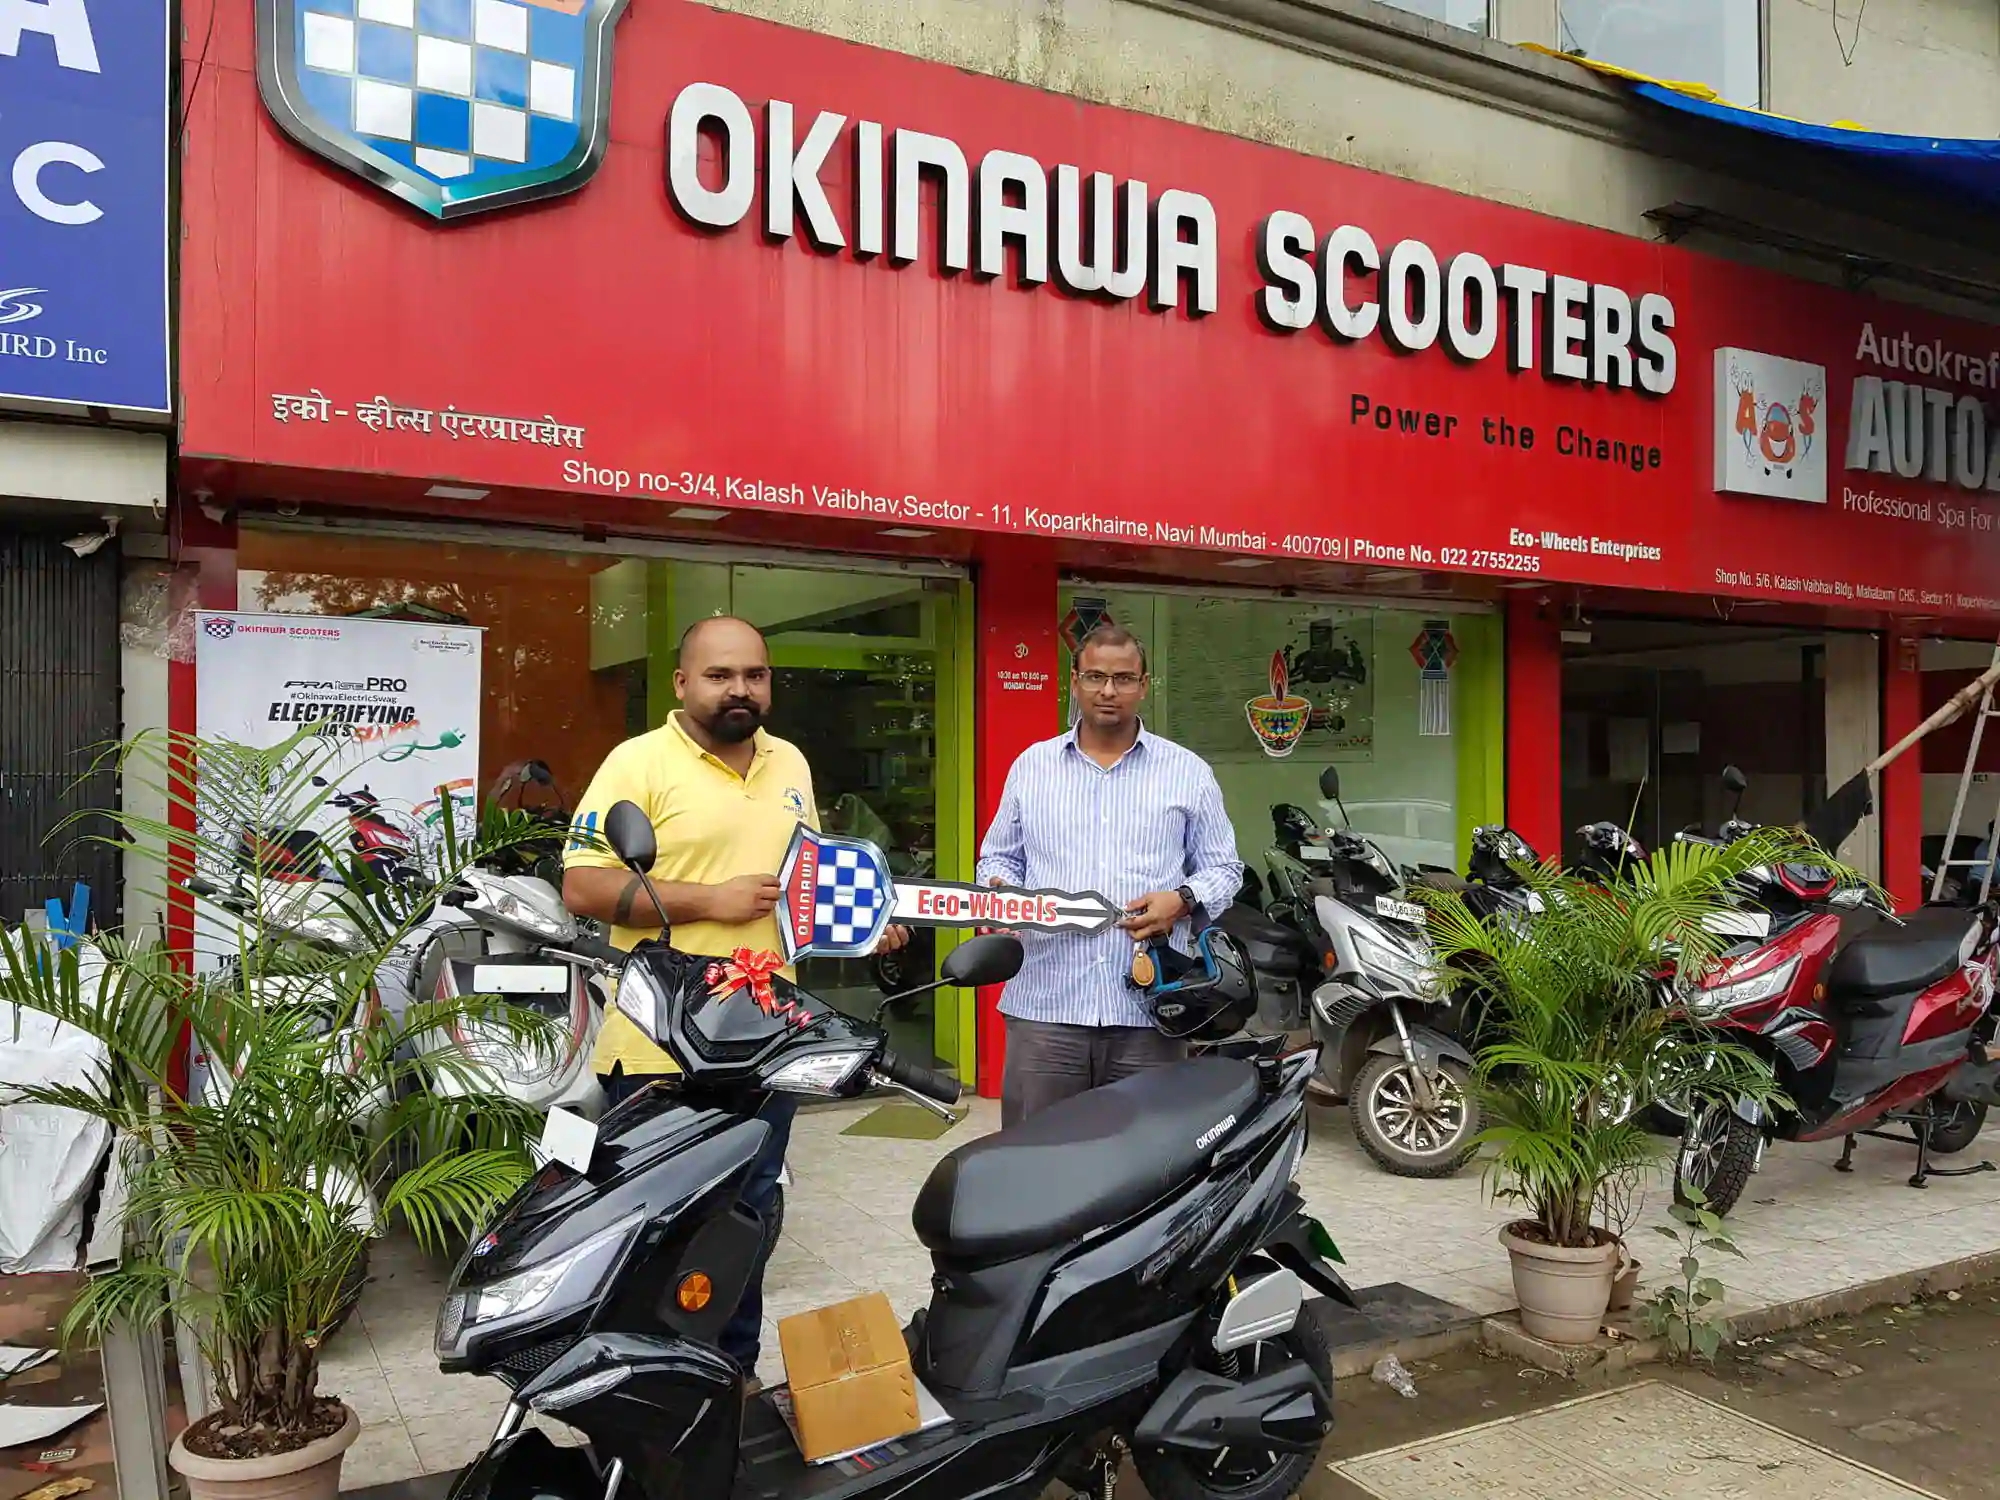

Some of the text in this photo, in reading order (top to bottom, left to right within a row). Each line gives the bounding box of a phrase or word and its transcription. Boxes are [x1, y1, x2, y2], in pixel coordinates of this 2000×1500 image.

[667, 82, 1677, 397] OKINAWA SCOOTERS
[65, 340, 107, 364] Inc
[272, 388, 331, 423] इको
[356, 395, 433, 432] व्हील्स
[439, 404, 585, 449] एंटरप्रायझेस
[1351, 394, 1661, 472] Power the Change
[563, 460, 631, 492] Shop
[726, 477, 804, 505] Kalash
[1200, 526, 1266, 550] Mumbai
[1282, 535, 1341, 557] 400709
[1354, 539, 1405, 561] Phone
[1410, 545, 1436, 563] No.
[1441, 547, 1467, 566] 022
[1472, 550, 1540, 573] 27552255
[1843, 487, 1993, 531] Professional Spa For
[1510, 527, 1661, 562] Eco-Wheels Enterprises
[1715, 568, 1738, 585] Shop
[1739, 571, 1753, 586] No.
[1756, 573, 1772, 589] 5/6,
[1774, 575, 1801, 592] Kalash
[1803, 578, 1833, 595] Vaibhav
[237, 625, 340, 637] OKINAWA SCOOTERS
[290, 692, 398, 704] #OkinawaElectricSwag
[366, 677, 409, 692] PRO
[268, 702, 415, 724] ELECTRIFYING
[797, 850, 815, 936] OKINAWA
[1195, 1114, 1236, 1150] OKINAWA
